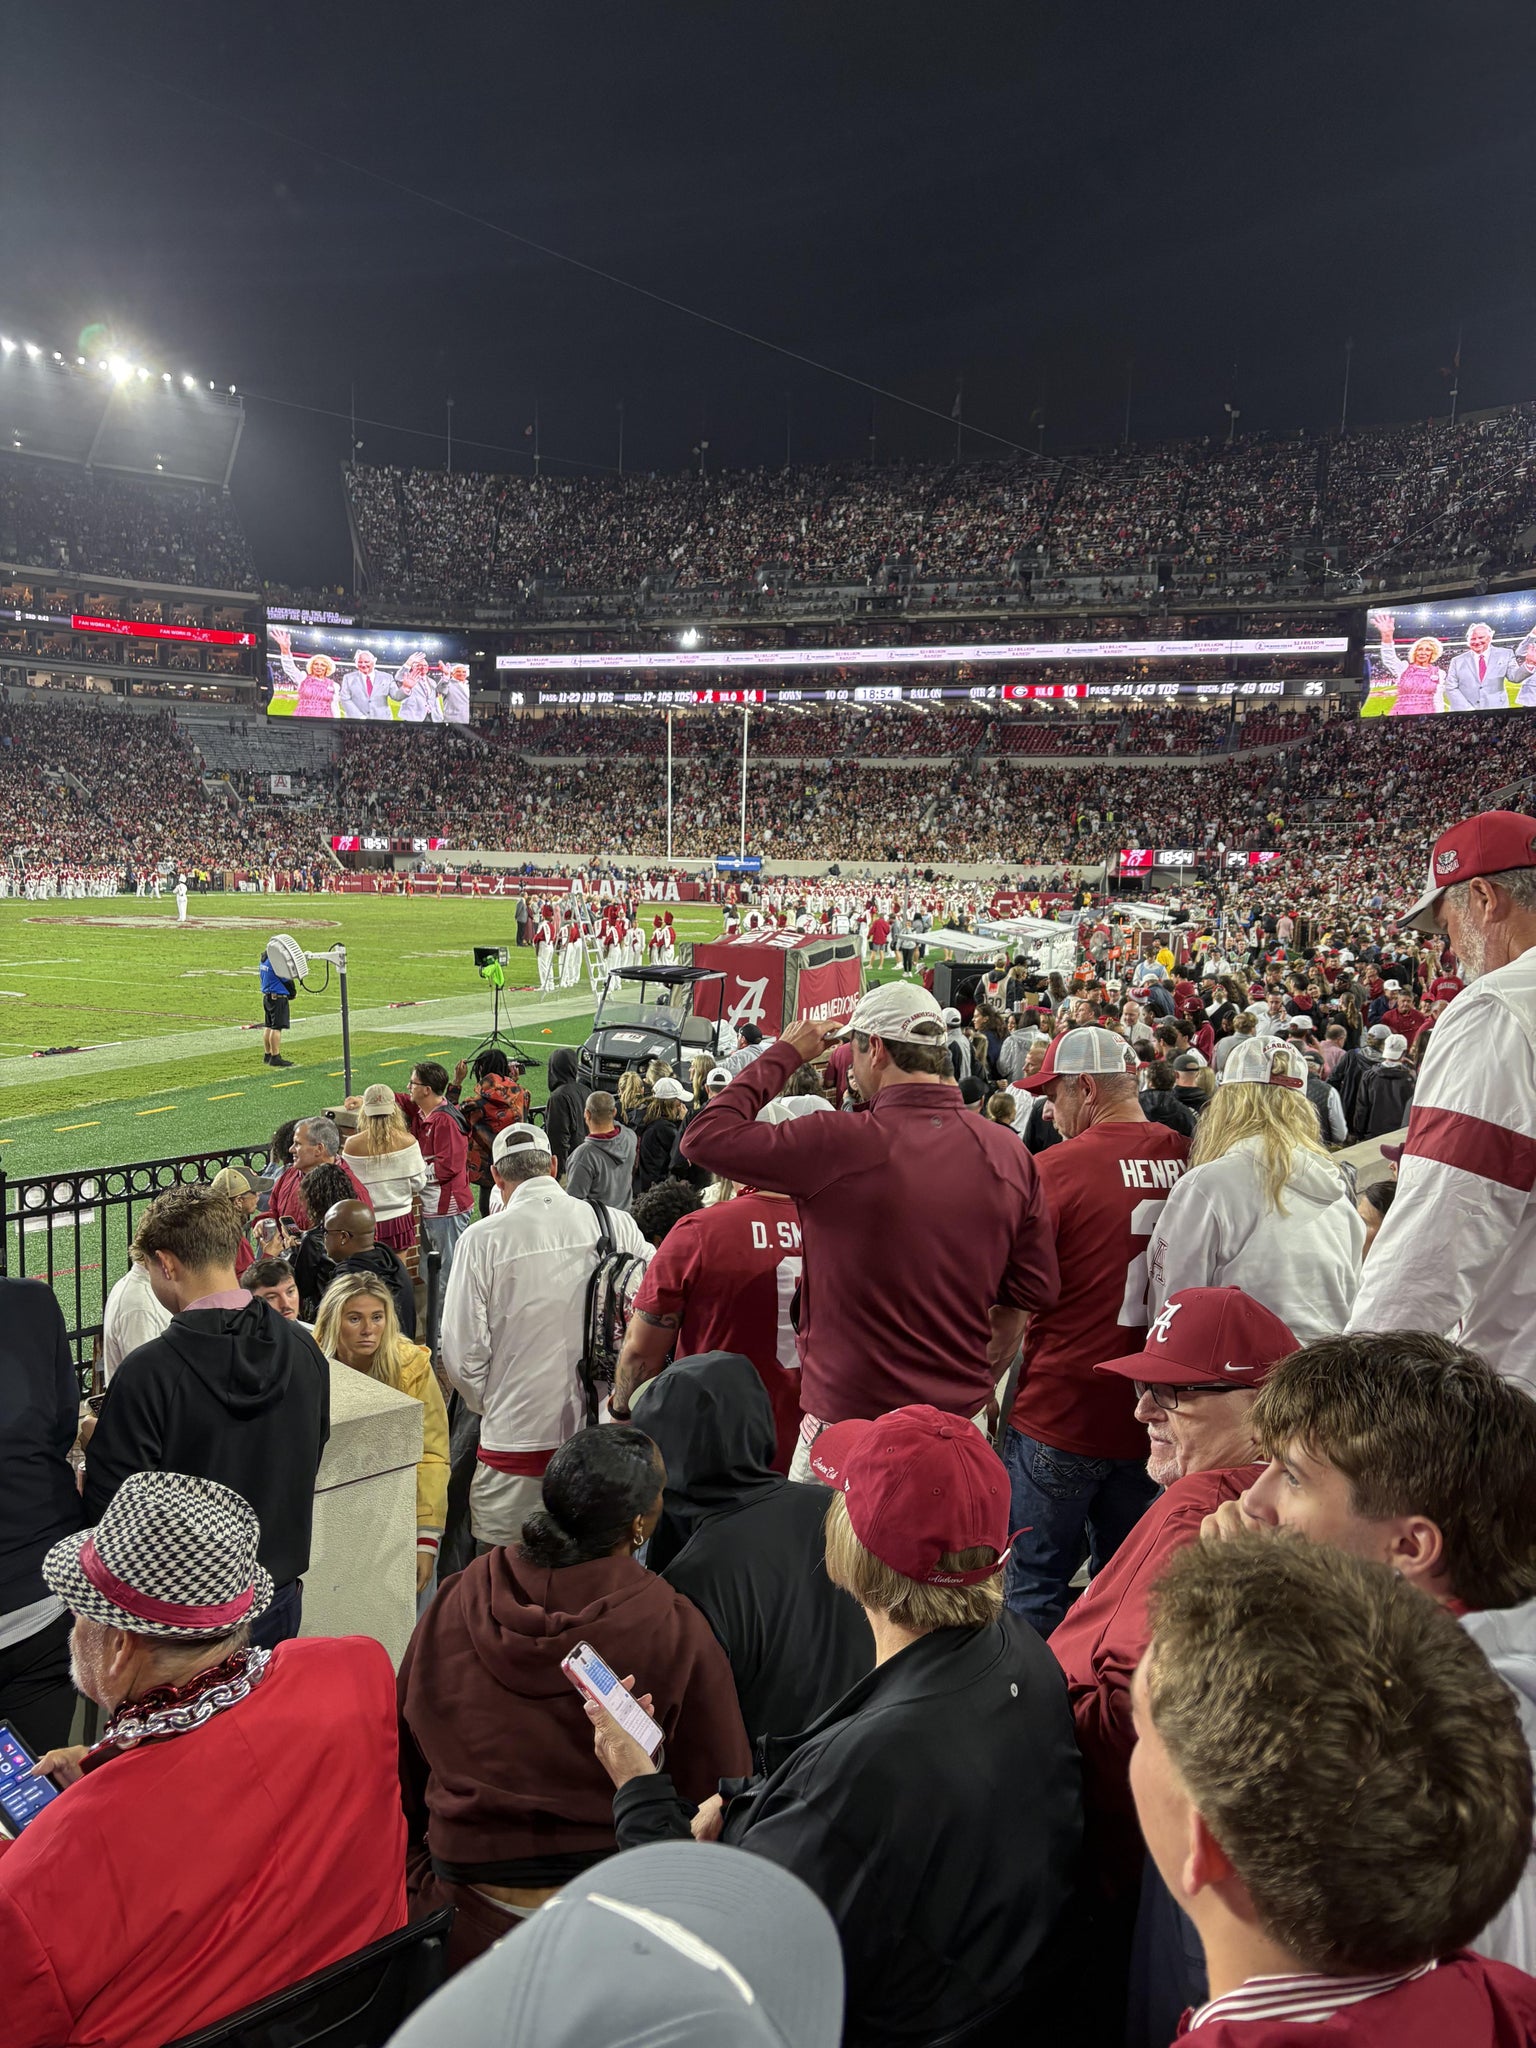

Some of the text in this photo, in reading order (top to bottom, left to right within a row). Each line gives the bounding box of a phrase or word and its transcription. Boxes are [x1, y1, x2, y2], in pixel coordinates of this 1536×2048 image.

[862, 689, 894, 699] 18:54
[987, 686, 996, 698] 2
[1062, 685, 1077, 697] 10
[1158, 683, 1180, 695] YDS
[1258, 683, 1280, 694] YDS
[1304, 682, 1323, 695] 25
[598, 692, 614, 702] YDS
[743, 690, 757, 702] 14
[363, 837, 388, 850] 18:54
[413, 839, 427, 851] 25
[1159, 851, 1193, 864] 18:54
[1228, 852, 1247, 865] 25
[489, 877, 506, 894] A
[571, 879, 681, 901] ALABMA
[727, 974, 770, 1028] A
[751, 1221, 774, 1249] D.
[1146, 1300, 1182, 1343] A
